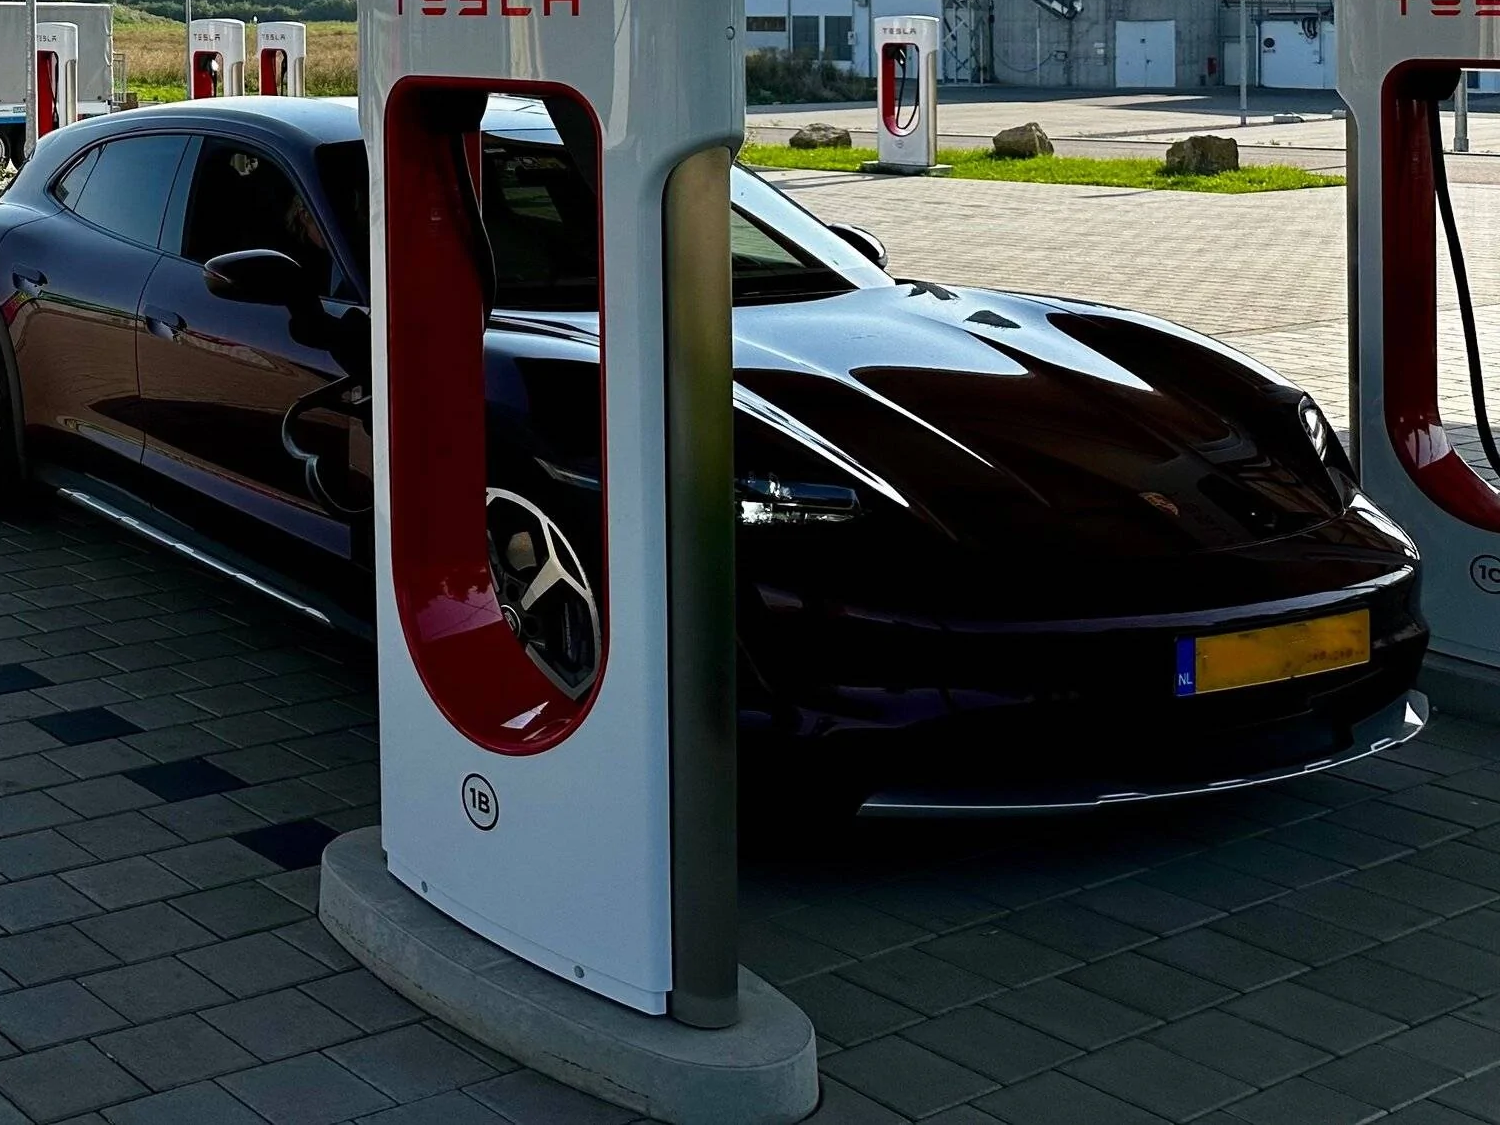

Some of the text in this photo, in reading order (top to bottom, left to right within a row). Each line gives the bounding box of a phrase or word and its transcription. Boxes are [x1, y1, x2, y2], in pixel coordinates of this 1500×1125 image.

[882, 27, 917, 35] TESLA
[193, 33, 221, 41] TESLA
[261, 33, 286, 41] TESLA
[1178, 672, 1193, 686] NL
[469, 787, 491, 814] 1B
